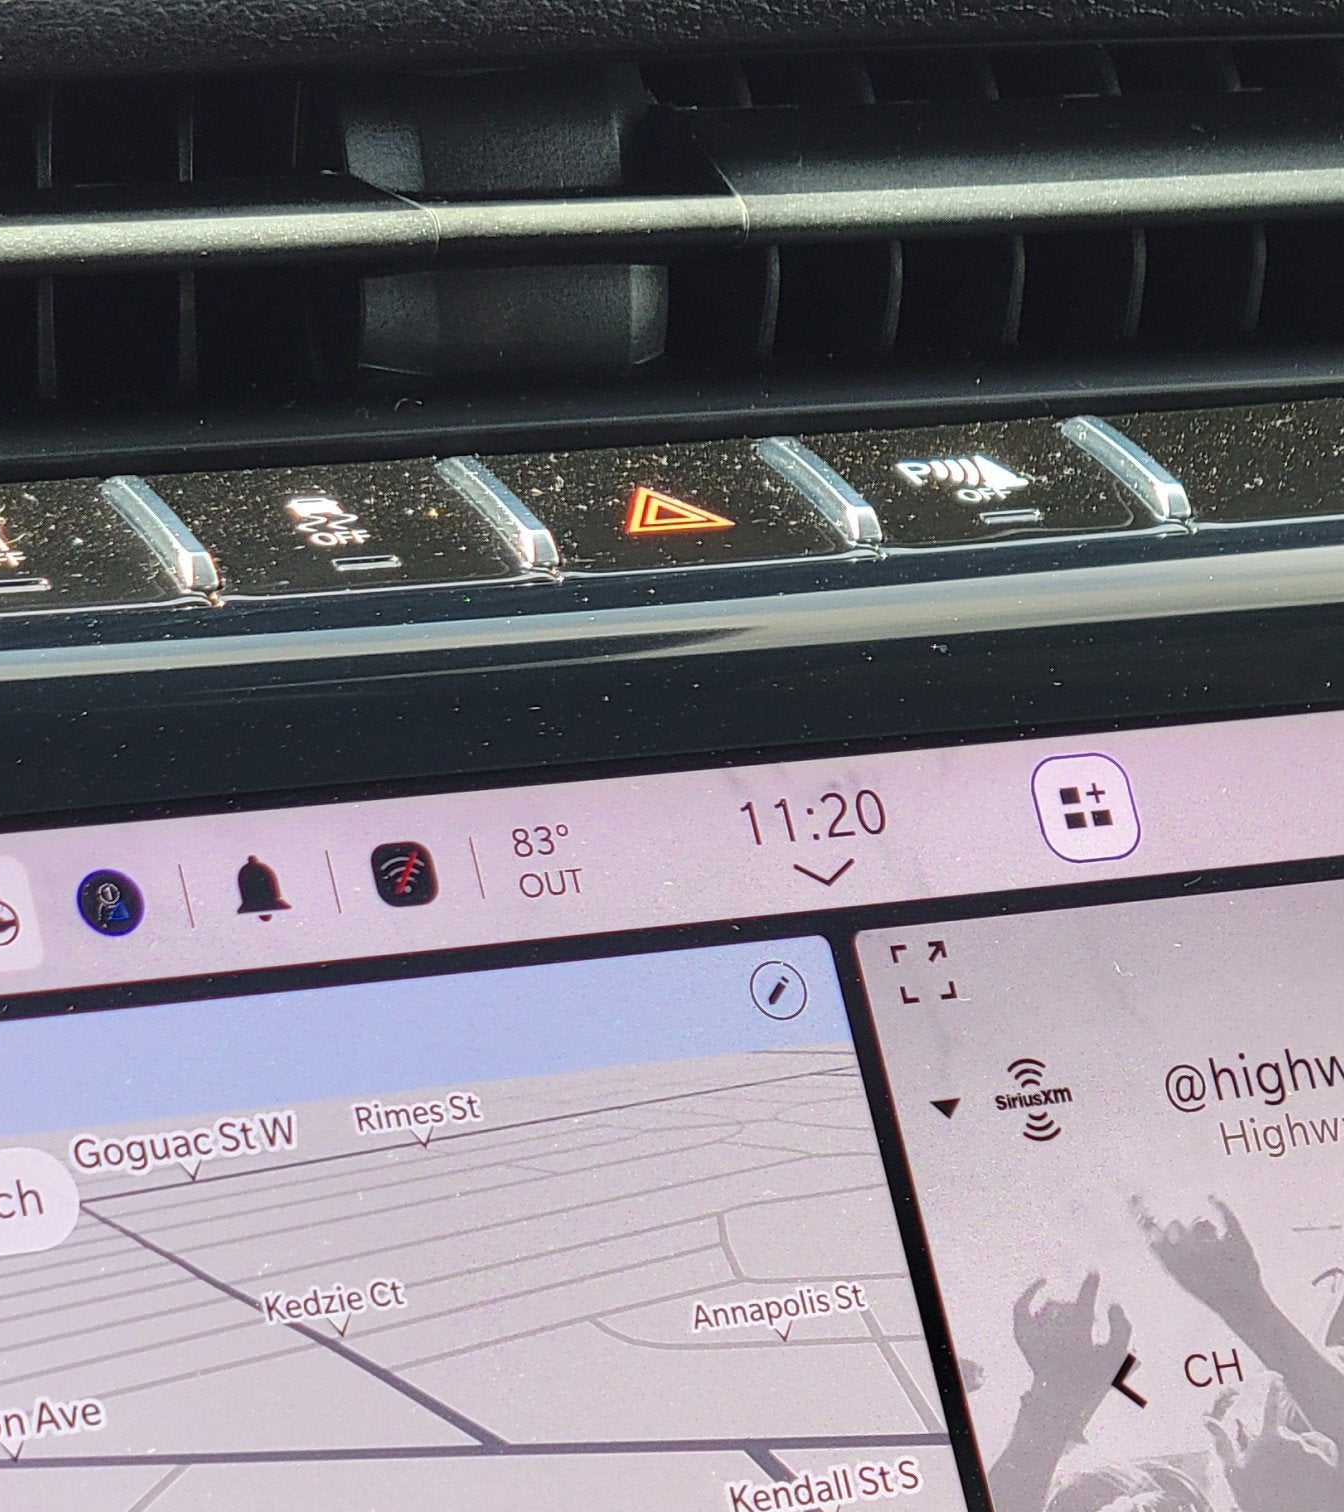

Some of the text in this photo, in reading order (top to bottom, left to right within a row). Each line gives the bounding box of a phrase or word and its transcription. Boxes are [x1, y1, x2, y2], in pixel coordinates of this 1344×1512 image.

[956, 487, 1011, 504] OFF
[309, 529, 372, 546] OFF
[740, 788, 887, 846] 11:20
[519, 867, 584, 900] OUT
[355, 1094, 481, 1134] Rimes St
[73, 1114, 295, 1170] Goguac St W
[263, 1280, 406, 1323] Kedzie Ct
[692, 1282, 866, 1331] Annapolis St
[1183, 1347, 1245, 1389] CH
[35, 1400, 104, 1435] Ave
[858, 1464, 894, 1497] St
[897, 1459, 921, 1490] S
